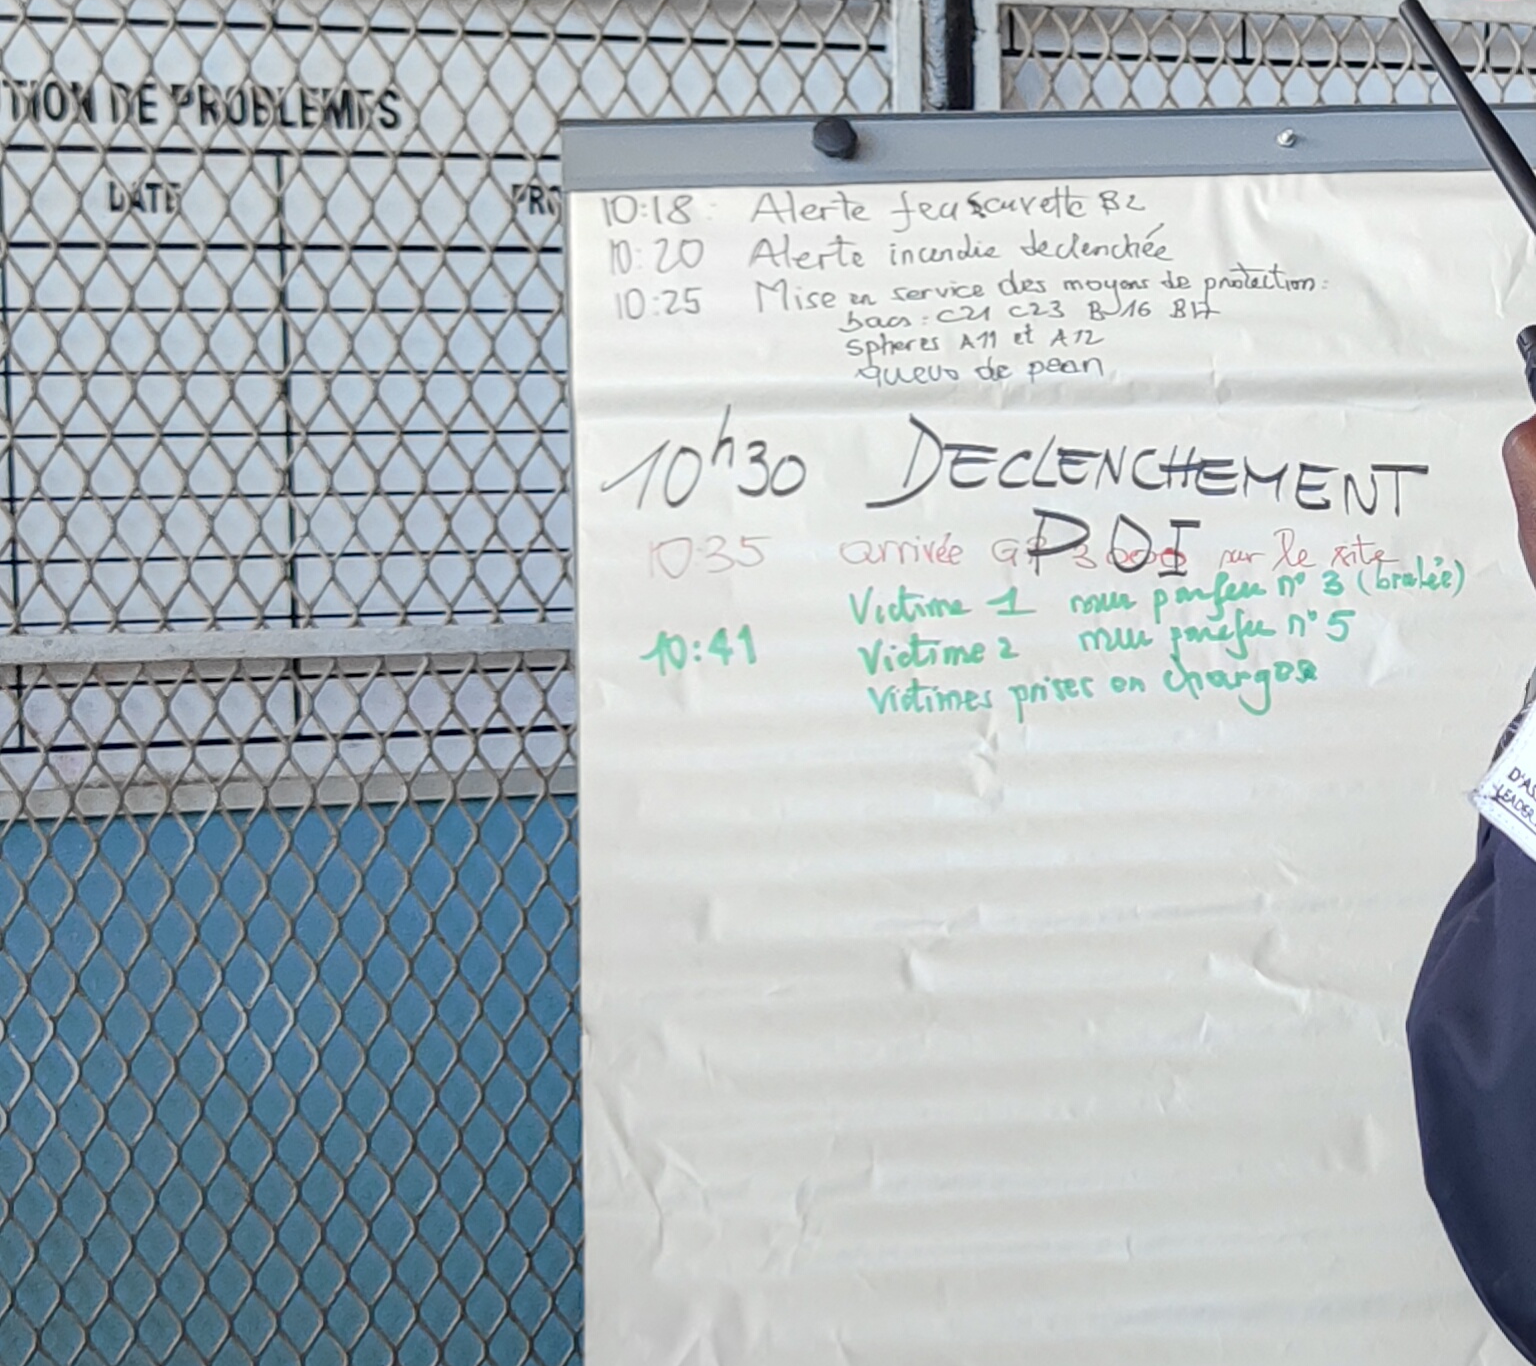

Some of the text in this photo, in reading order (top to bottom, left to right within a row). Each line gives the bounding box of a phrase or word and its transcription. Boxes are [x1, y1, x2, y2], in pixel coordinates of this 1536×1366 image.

[110, 81, 158, 125] DE
[108, 181, 182, 213] DATE
[750, 189, 871, 225] Alerte
[1098, 189, 1147, 217] B2
[608, 237, 705, 275] 10:20
[748, 233, 867, 270] Alerte
[889, 231, 1001, 267] incendie
[614, 286, 703, 320] 10:25
[754, 277, 837, 314] Mise
[891, 283, 986, 303] service
[998, 269, 1047, 295] des
[1160, 268, 1192, 292] de
[1012, 324, 1035, 347] et
[974, 355, 1013, 382] de
[600, 404, 1429, 517] 10h30 DECLENCHEMENT
[839, 532, 963, 566] arrivée
[1027, 507, 1201, 578] POI
[849, 585, 972, 625] Victime
[985, 586, 1037, 617] 1
[1322, 572, 1346, 596] 3
[640, 624, 758, 677] 10:41
[857, 631, 986, 676] Victime
[998, 636, 1020, 660] 2
[1326, 609, 1357, 642] 5
[867, 677, 993, 715] Victimes
[1009, 676, 1094, 723] prises
